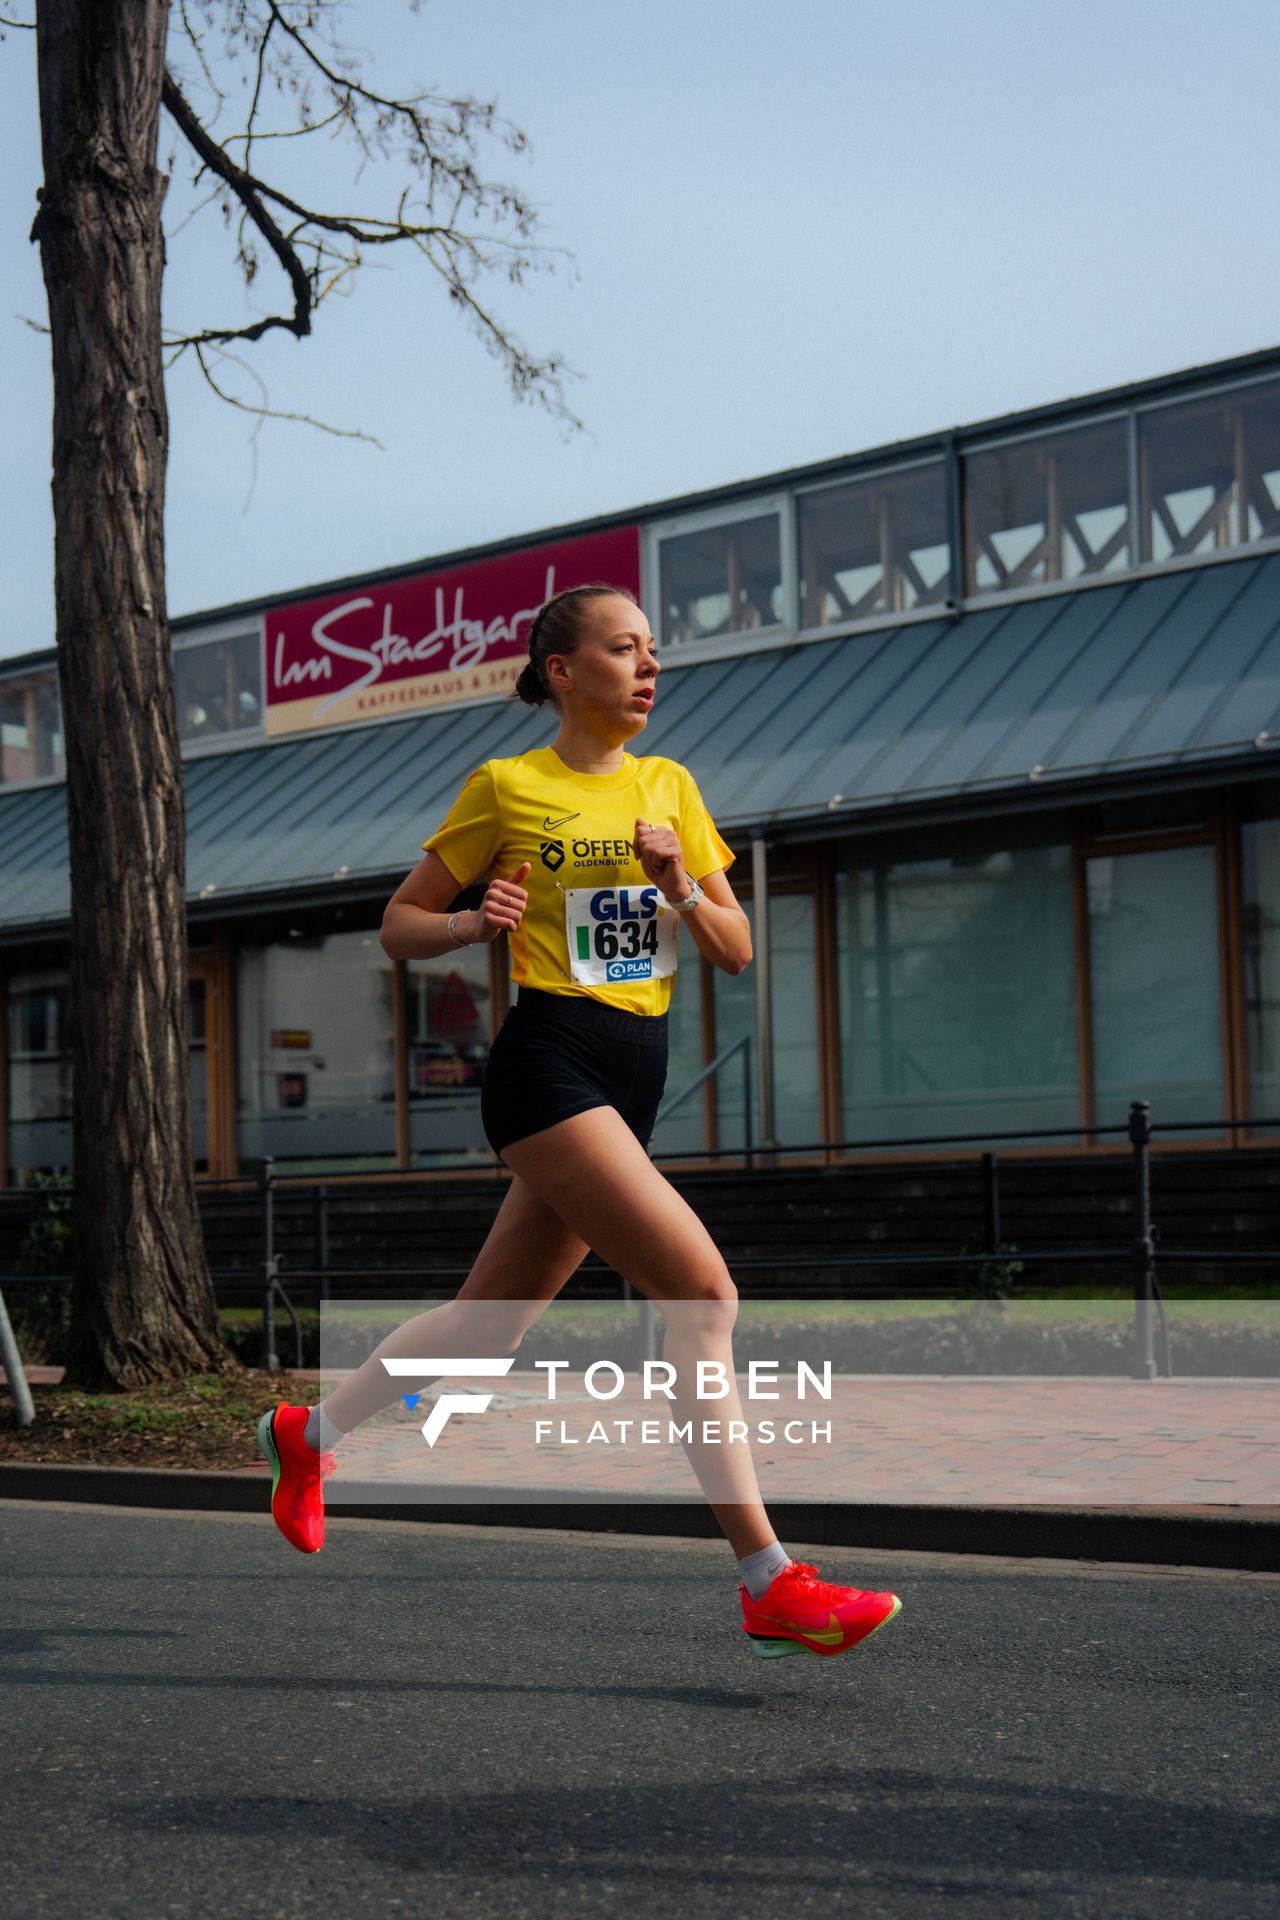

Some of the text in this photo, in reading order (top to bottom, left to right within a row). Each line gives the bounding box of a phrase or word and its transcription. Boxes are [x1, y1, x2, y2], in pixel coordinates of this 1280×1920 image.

[356, 677, 464, 711] KAFFEEHAUS
[573, 858, 630, 868] OLDENBURG
[589, 888, 659, 922] GLS
[594, 920, 659, 960] 634
[627, 962, 651, 972] PLAN
